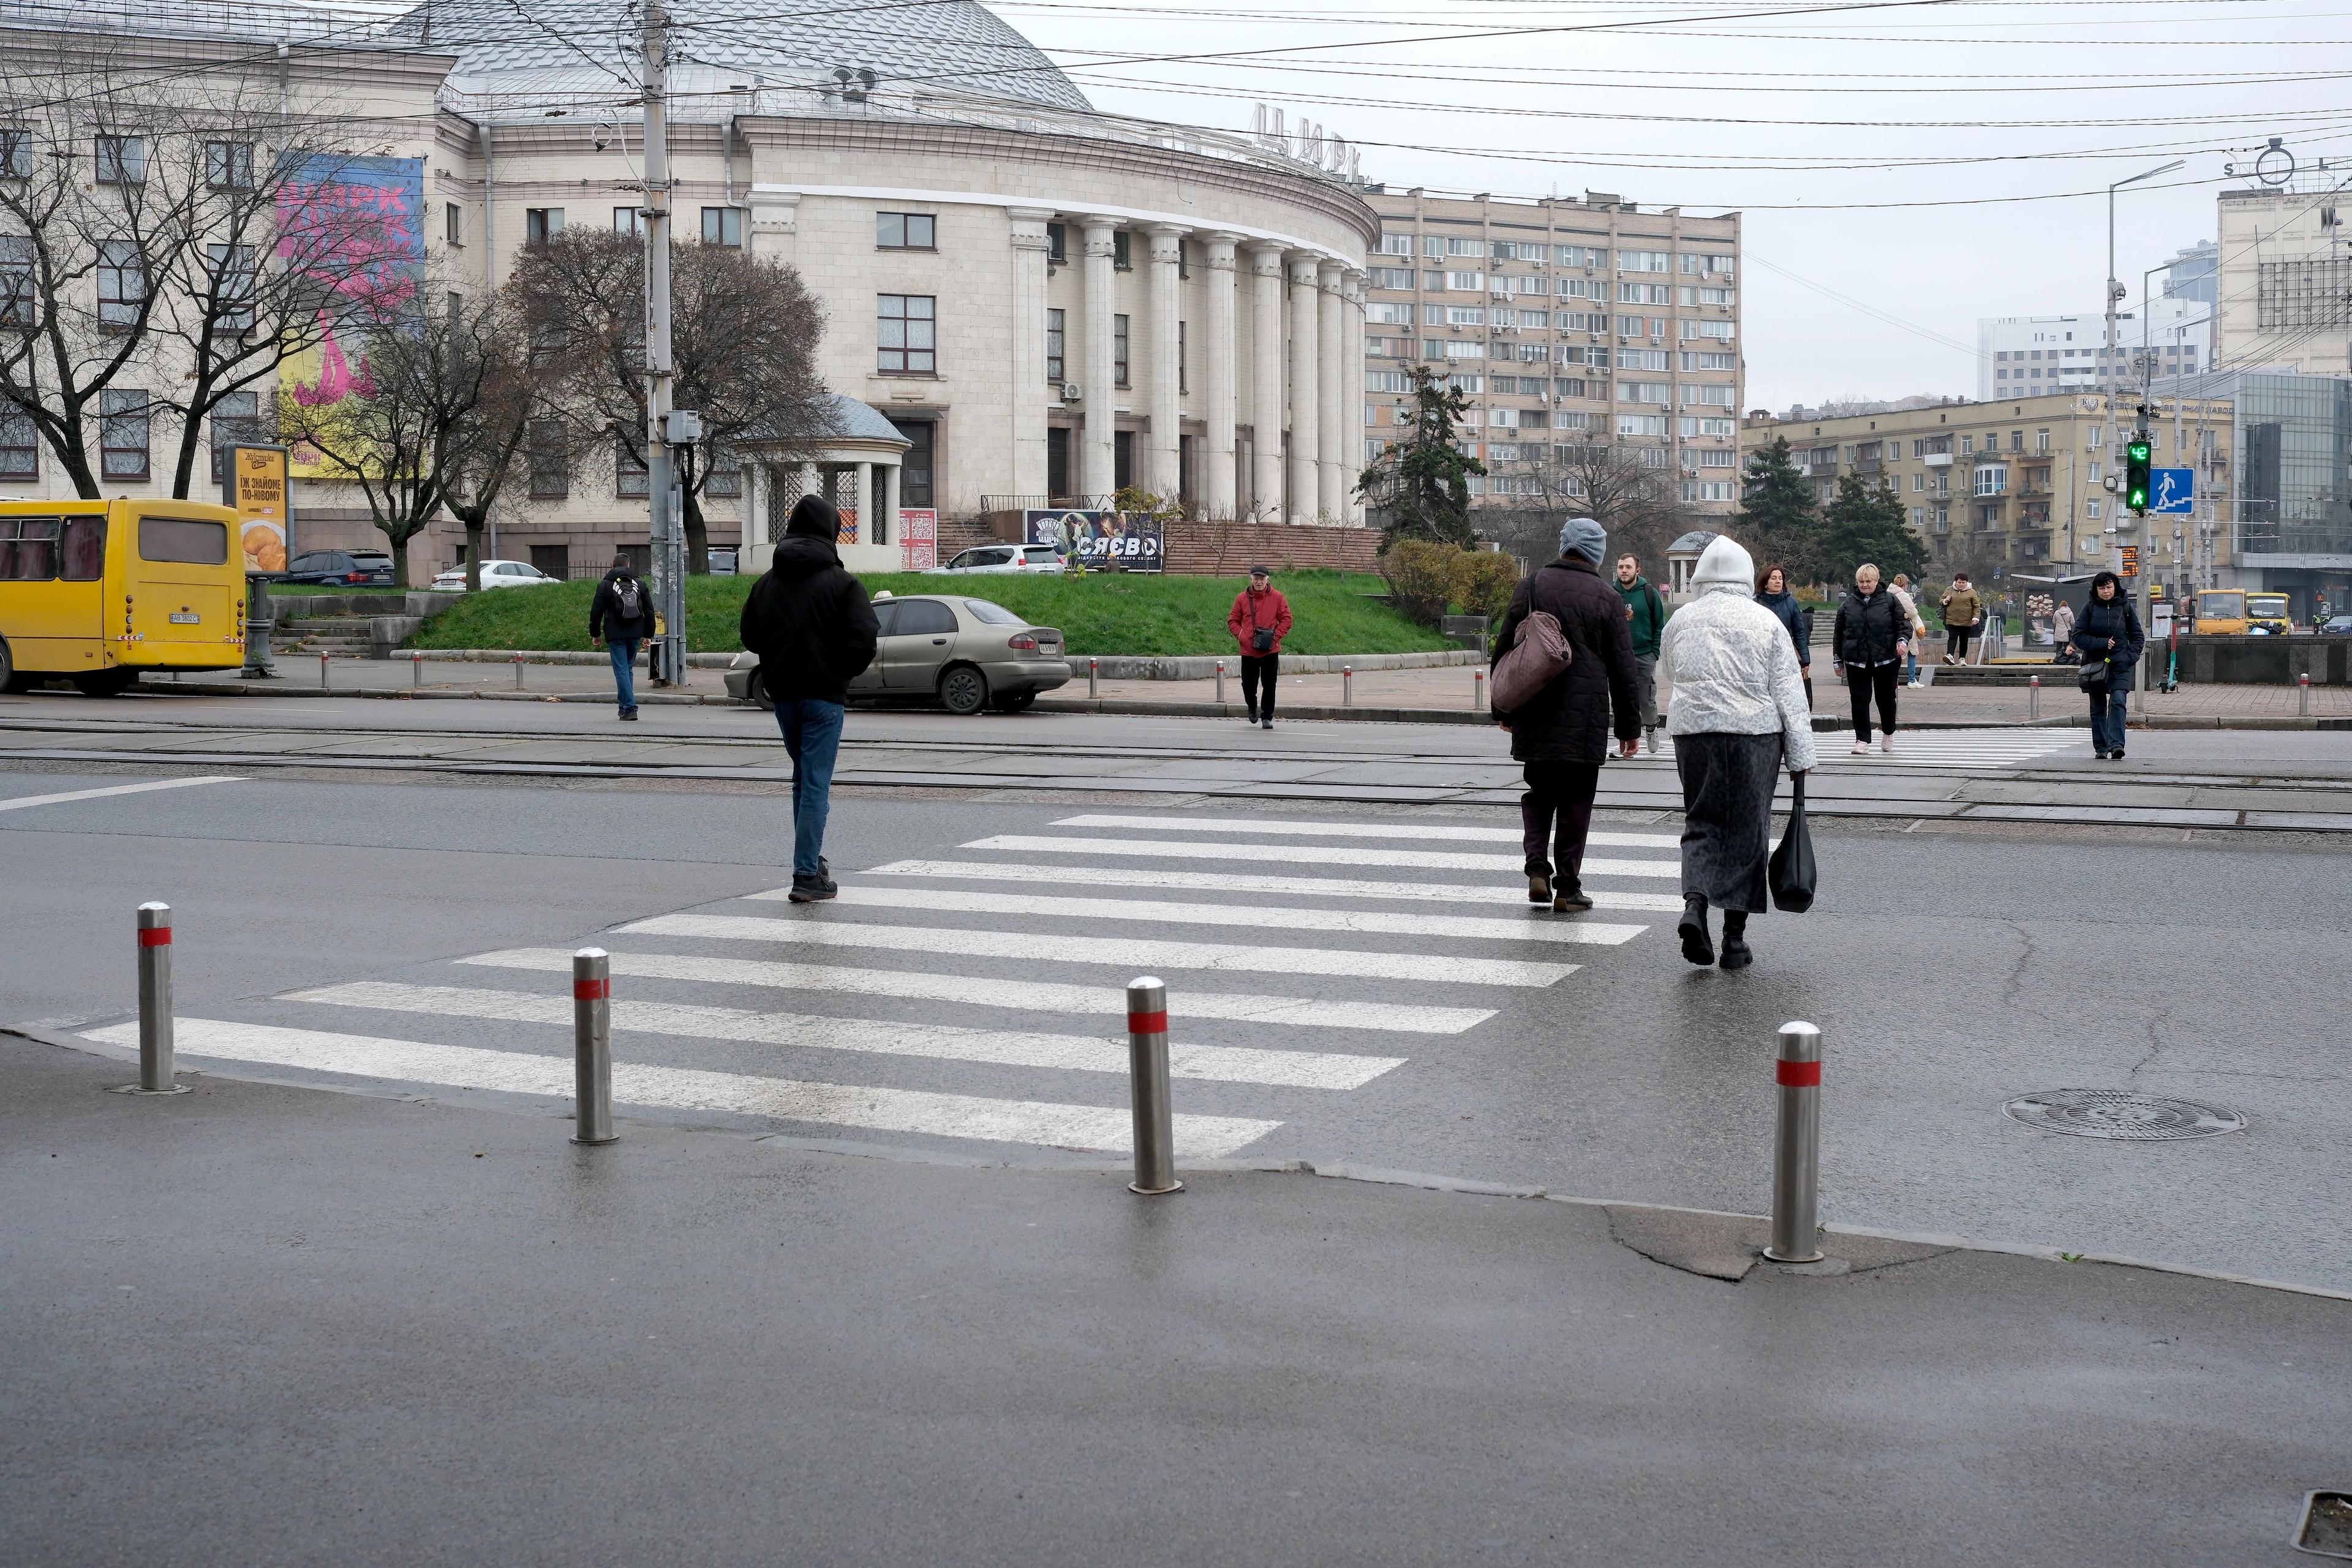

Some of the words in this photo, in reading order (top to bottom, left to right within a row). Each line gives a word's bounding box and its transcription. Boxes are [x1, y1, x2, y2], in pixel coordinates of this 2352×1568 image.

[1255, 102, 1360, 193] ЦИРК
[2132, 447, 2147, 459] 42
[240, 475, 250, 488] ЇЖ
[251, 476, 281, 490] ЗНАЙОМЕ
[242, 489, 280, 502] ПО-НОВОМУ
[1077, 537, 1157, 556] СЯЄВО
